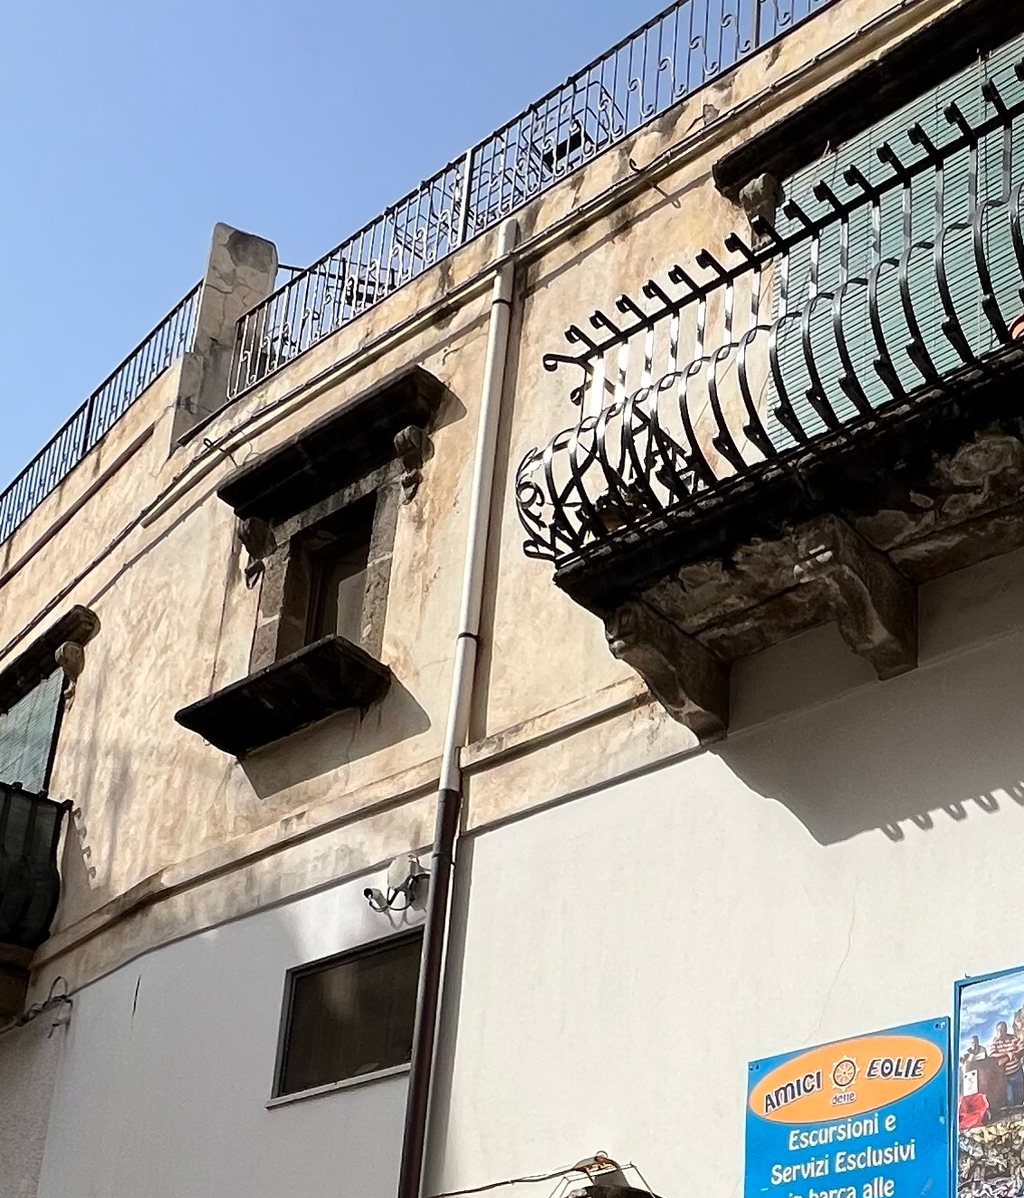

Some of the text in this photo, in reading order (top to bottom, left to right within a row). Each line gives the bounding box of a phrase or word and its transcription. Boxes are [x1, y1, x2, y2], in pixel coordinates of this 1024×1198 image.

[764, 1058, 926, 1113] AMICI EOLIE
[788, 1113, 897, 1150] Escursioni e
[771, 1139, 916, 1185] Servizi Esclusivi
[862, 1177, 895, 1198] alle
